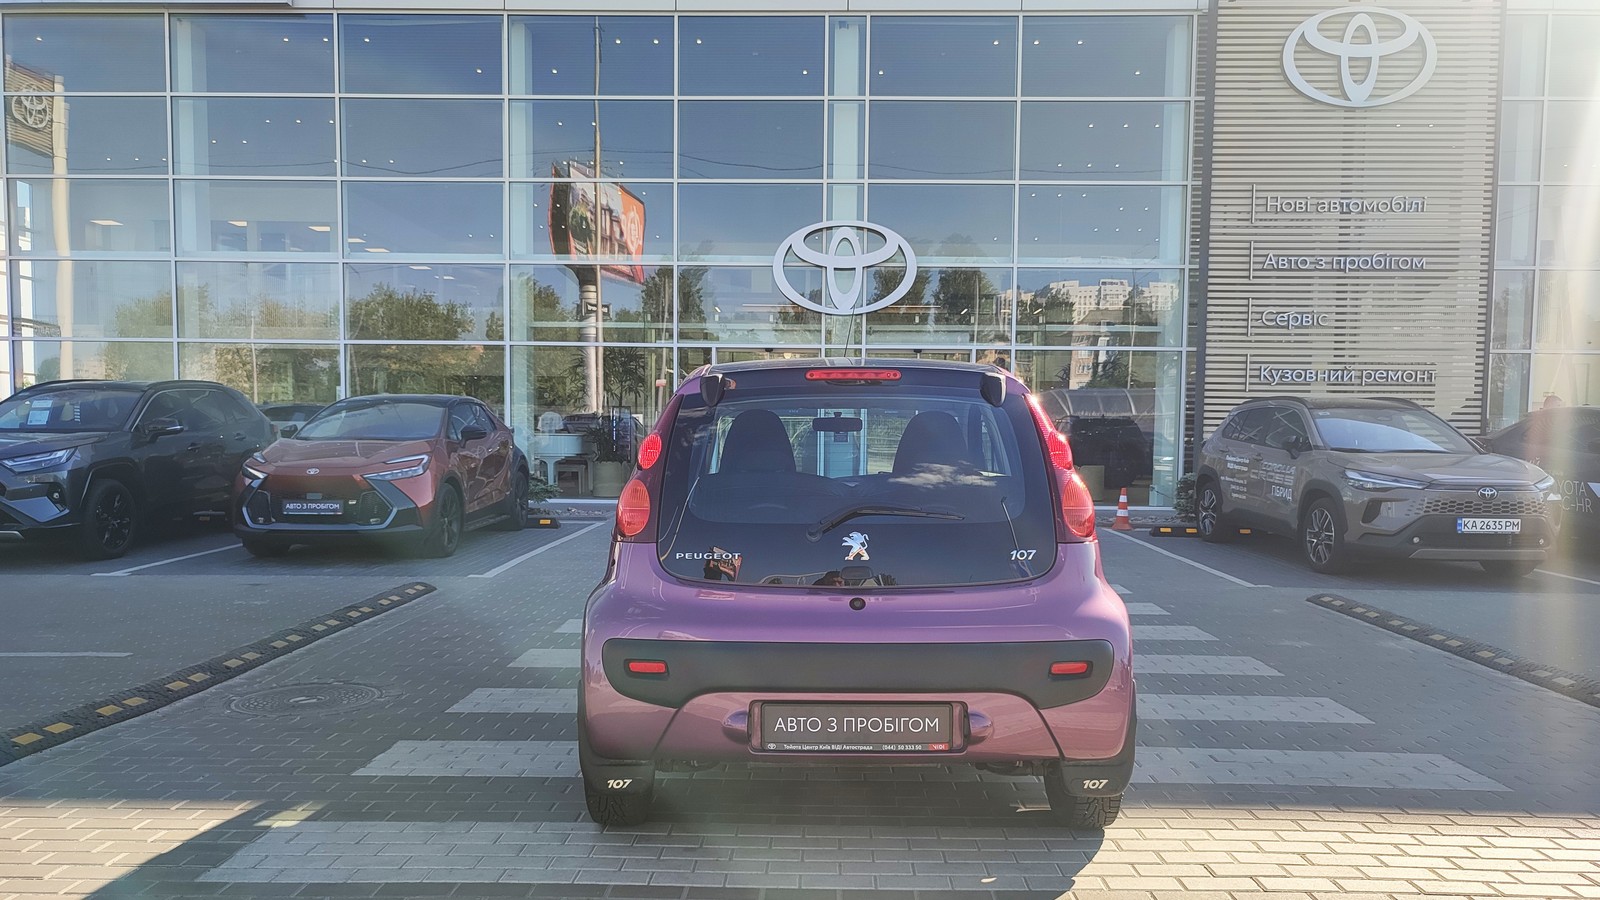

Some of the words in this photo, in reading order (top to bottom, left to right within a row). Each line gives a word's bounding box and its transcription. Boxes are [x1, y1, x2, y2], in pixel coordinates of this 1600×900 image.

[1266, 195, 1310, 212] Нові
[1317, 195, 1427, 212] автомобілі
[1262, 253, 1310, 269] Авто
[1315, 256, 1326, 269] з
[1332, 252, 1426, 273] пробігом
[1261, 309, 1329, 330] Сервіс
[1259, 365, 1355, 386] Кузовний
[1362, 369, 1437, 386] ремонт
[1250, 469, 1294, 486] CROSS
[1562, 495, 1593, 513] C-HR
[1463, 520, 1478, 531] KA
[1479, 520, 1503, 531] 2635
[1504, 520, 1520, 531] PM
[675, 552, 741, 560] PEUGEOT
[1010, 549, 1037, 561] 107
[774, 717, 822, 732] АВТО
[827, 717, 838, 732] З
[843, 717, 939, 732] ПРОБІГОМ
[802, 743, 819, 751] Центр
[607, 779, 633, 789] 107
[1083, 779, 1109, 789] 107
